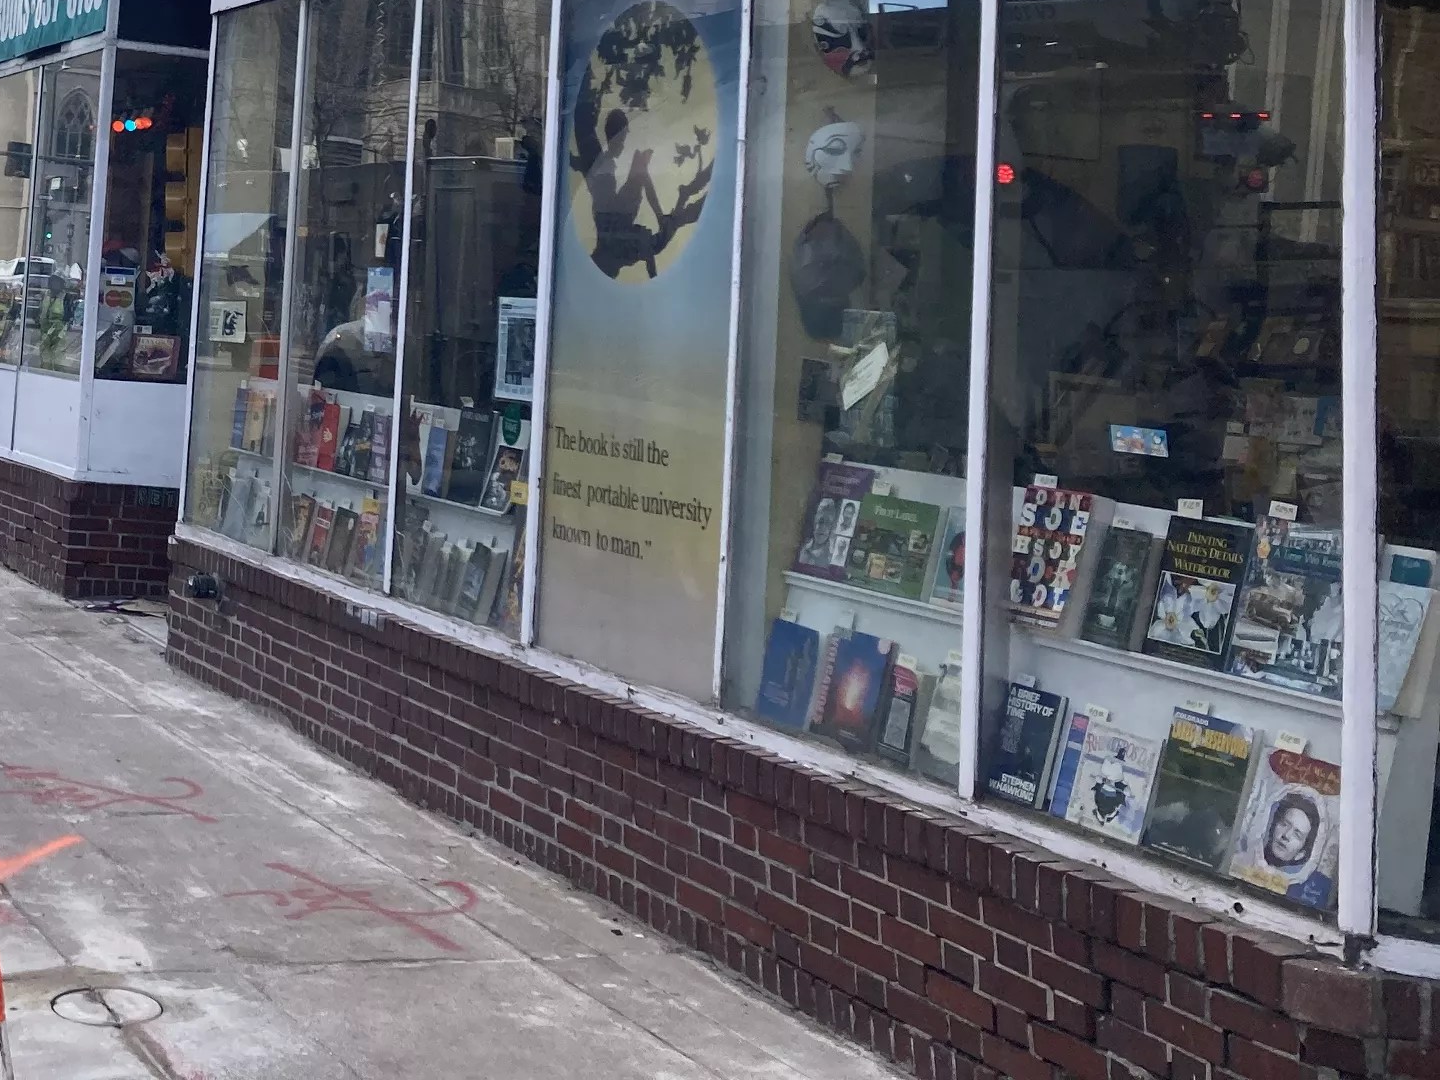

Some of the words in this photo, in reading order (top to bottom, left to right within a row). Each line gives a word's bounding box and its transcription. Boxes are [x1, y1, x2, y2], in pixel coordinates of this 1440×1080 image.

[578, 430, 608, 458] book
[610, 434, 621, 458] is
[622, 438, 644, 462] still
[647, 440, 669, 466] the
[552, 471, 581, 500] finest
[587, 484, 639, 510] portable
[641, 491, 712, 530] university
[552, 516, 591, 547] known
[596, 529, 608, 551] to
[610, 535, 652, 559] man."
[1187, 531, 1228, 549] PAINTING
[1209, 547, 1244, 564] DETAILS
[1174, 557, 1231, 579] WATERCOLOR
[1010, 686, 1017, 696] A
[1017, 688, 1041, 702] BRIEF
[1006, 705, 1026, 720] TIME
[1008, 697, 1043, 716] HISTORY
[1042, 706, 1055, 718] OF
[1001, 772, 1036, 793] STEPHEN
